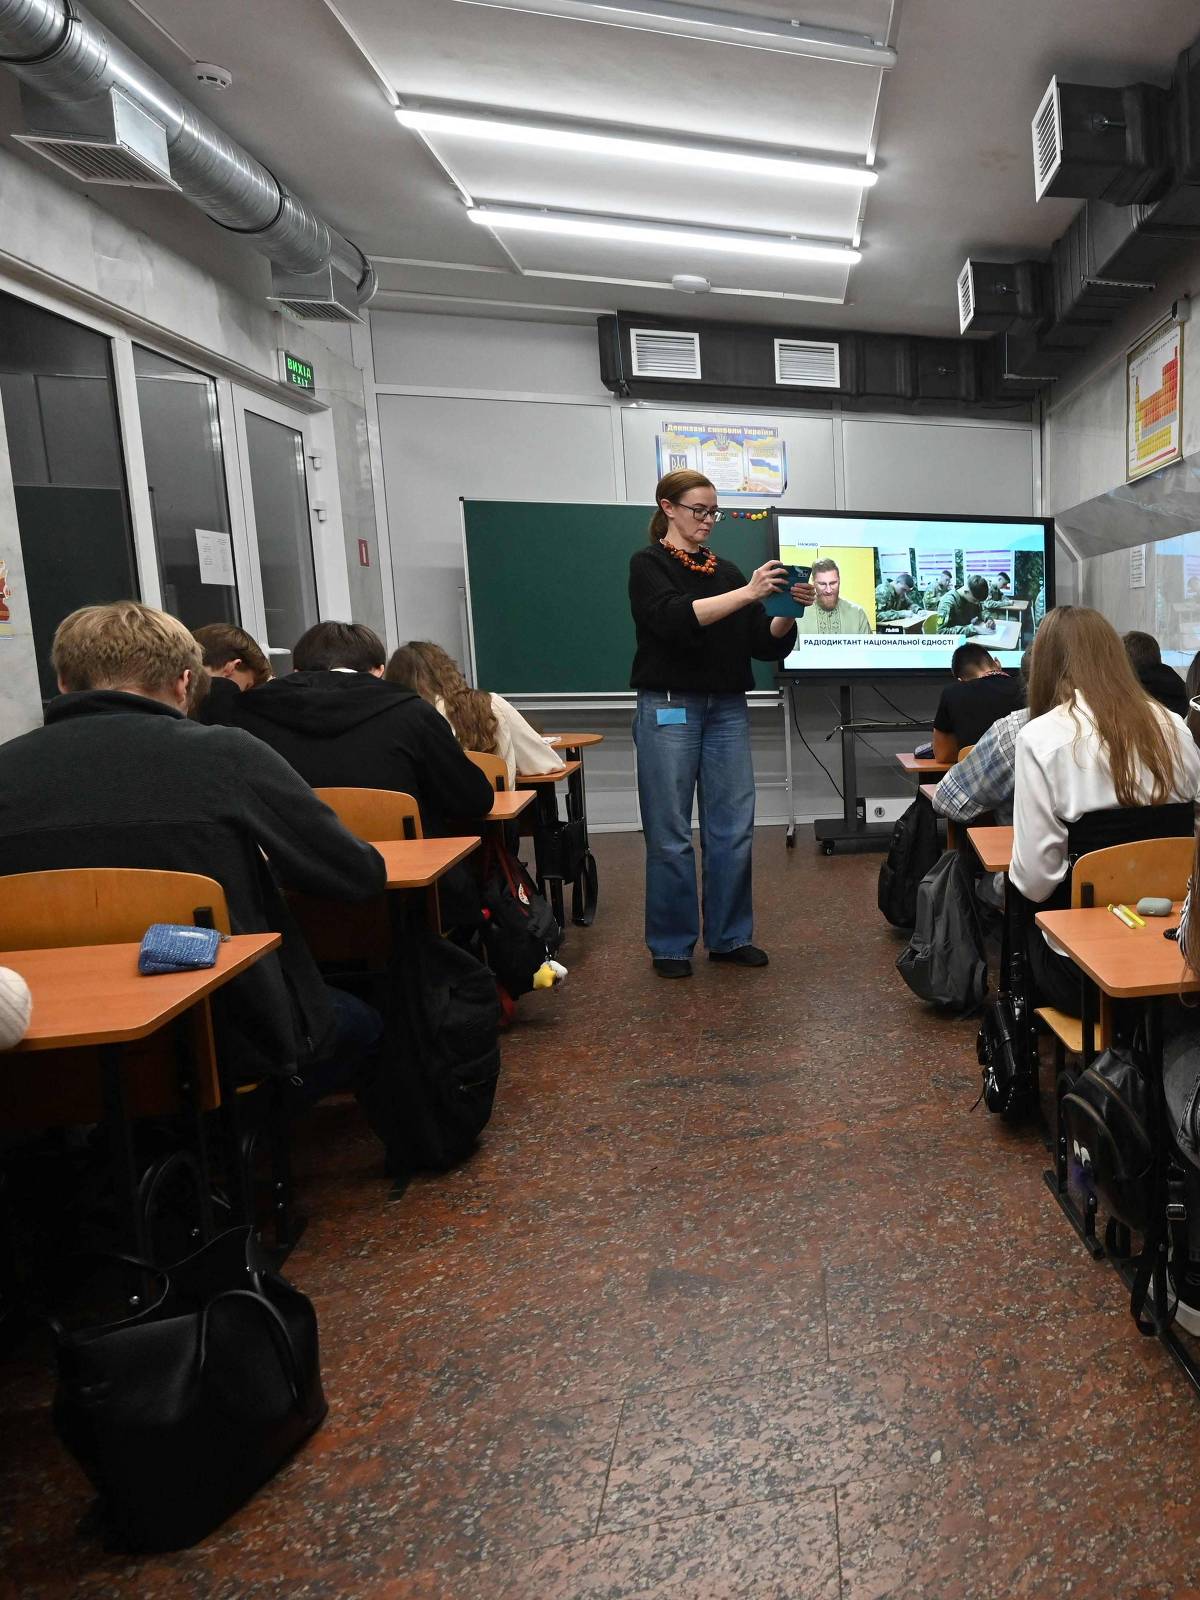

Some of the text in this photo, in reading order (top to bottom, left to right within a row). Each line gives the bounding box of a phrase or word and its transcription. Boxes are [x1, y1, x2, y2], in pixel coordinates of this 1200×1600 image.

[287, 358, 311, 380] ВИХІД
[292, 374, 308, 387] EXIT
[864, 638, 920, 646] НАЦІОНАЛЬНОЇ
